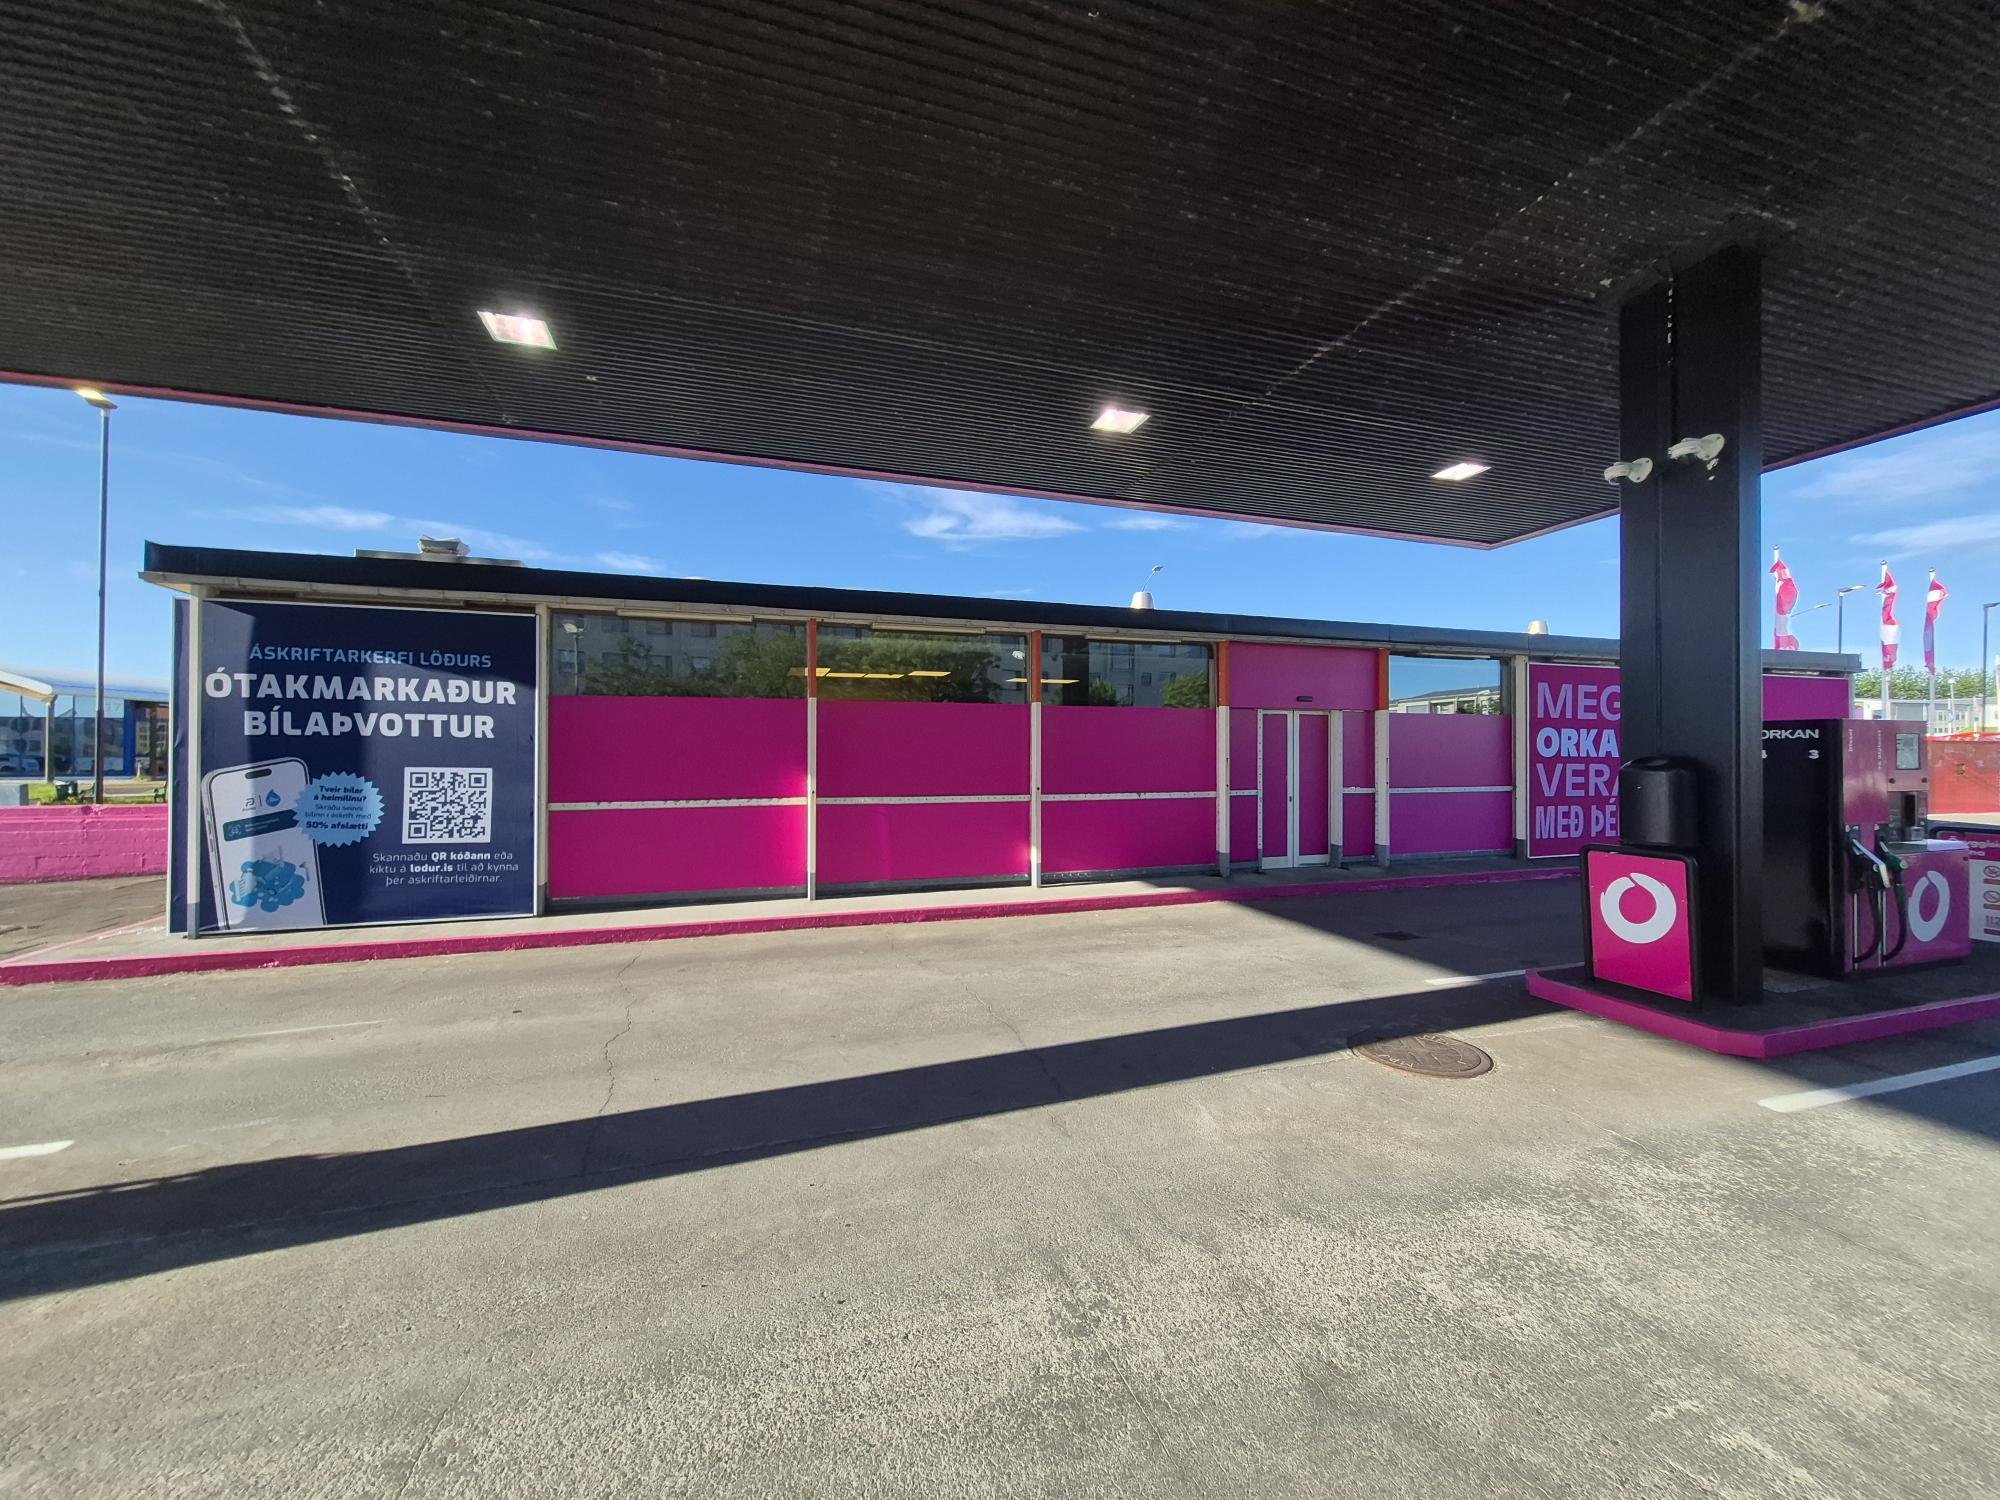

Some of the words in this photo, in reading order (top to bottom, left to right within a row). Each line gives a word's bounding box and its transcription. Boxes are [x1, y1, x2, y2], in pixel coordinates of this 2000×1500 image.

[250, 643, 413, 665] ÁSKRIFTARKERFI
[420, 650, 492, 668] LÖÐURS
[205, 667, 516, 705] ÓTAKMARKAÐUR
[244, 705, 495, 739] BÍLAÞVOTTUR
[1761, 729, 1819, 739] ORKAN
[1808, 749, 1819, 760] 3
[1536, 763, 1619, 797] VER
[319, 785, 341, 794] Tveir
[1535, 805, 1584, 839] MEÐ
[1590, 797, 1620, 838] ÞÉ
[305, 821, 329, 829] 50%
[330, 821, 369, 830] afslætti
[372, 852, 428, 862] Skannaðu
[431, 852, 447, 863] QR
[450, 851, 491, 861] kóðann
[493, 851, 513, 861] eða
[410, 863, 453, 873] lodur.is
[457, 863, 467, 872] til
[470, 862, 484, 872] að
[487, 862, 519, 873] kynna
